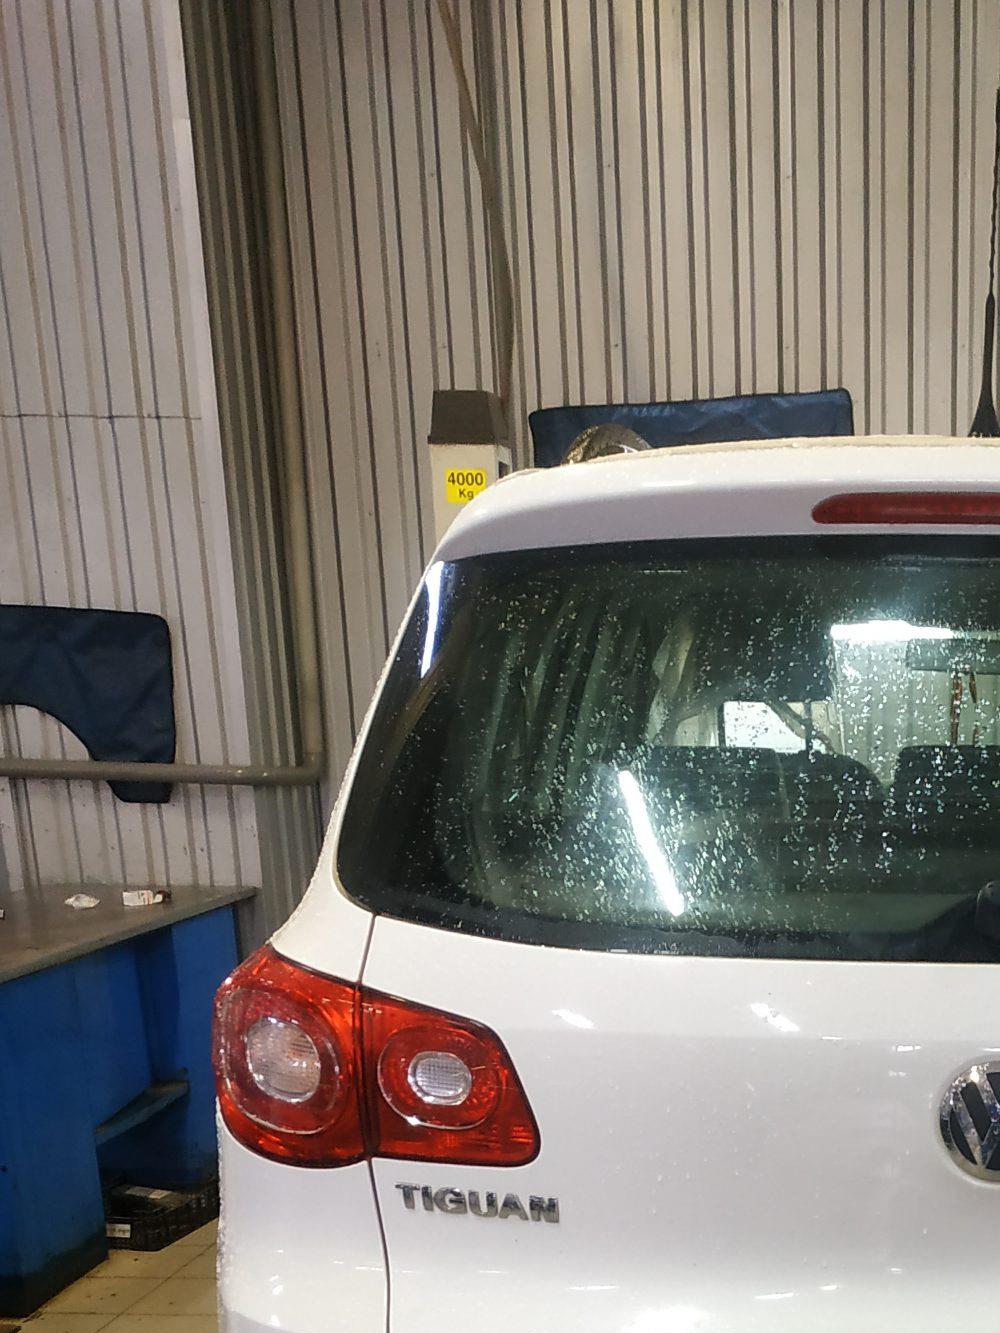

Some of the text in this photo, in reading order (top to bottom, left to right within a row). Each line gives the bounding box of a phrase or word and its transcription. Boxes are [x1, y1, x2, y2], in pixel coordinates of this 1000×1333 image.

[447, 472, 484, 486] 4000
[458, 488, 474, 500] Kg
[395, 1182, 560, 1223] TIGUAN
